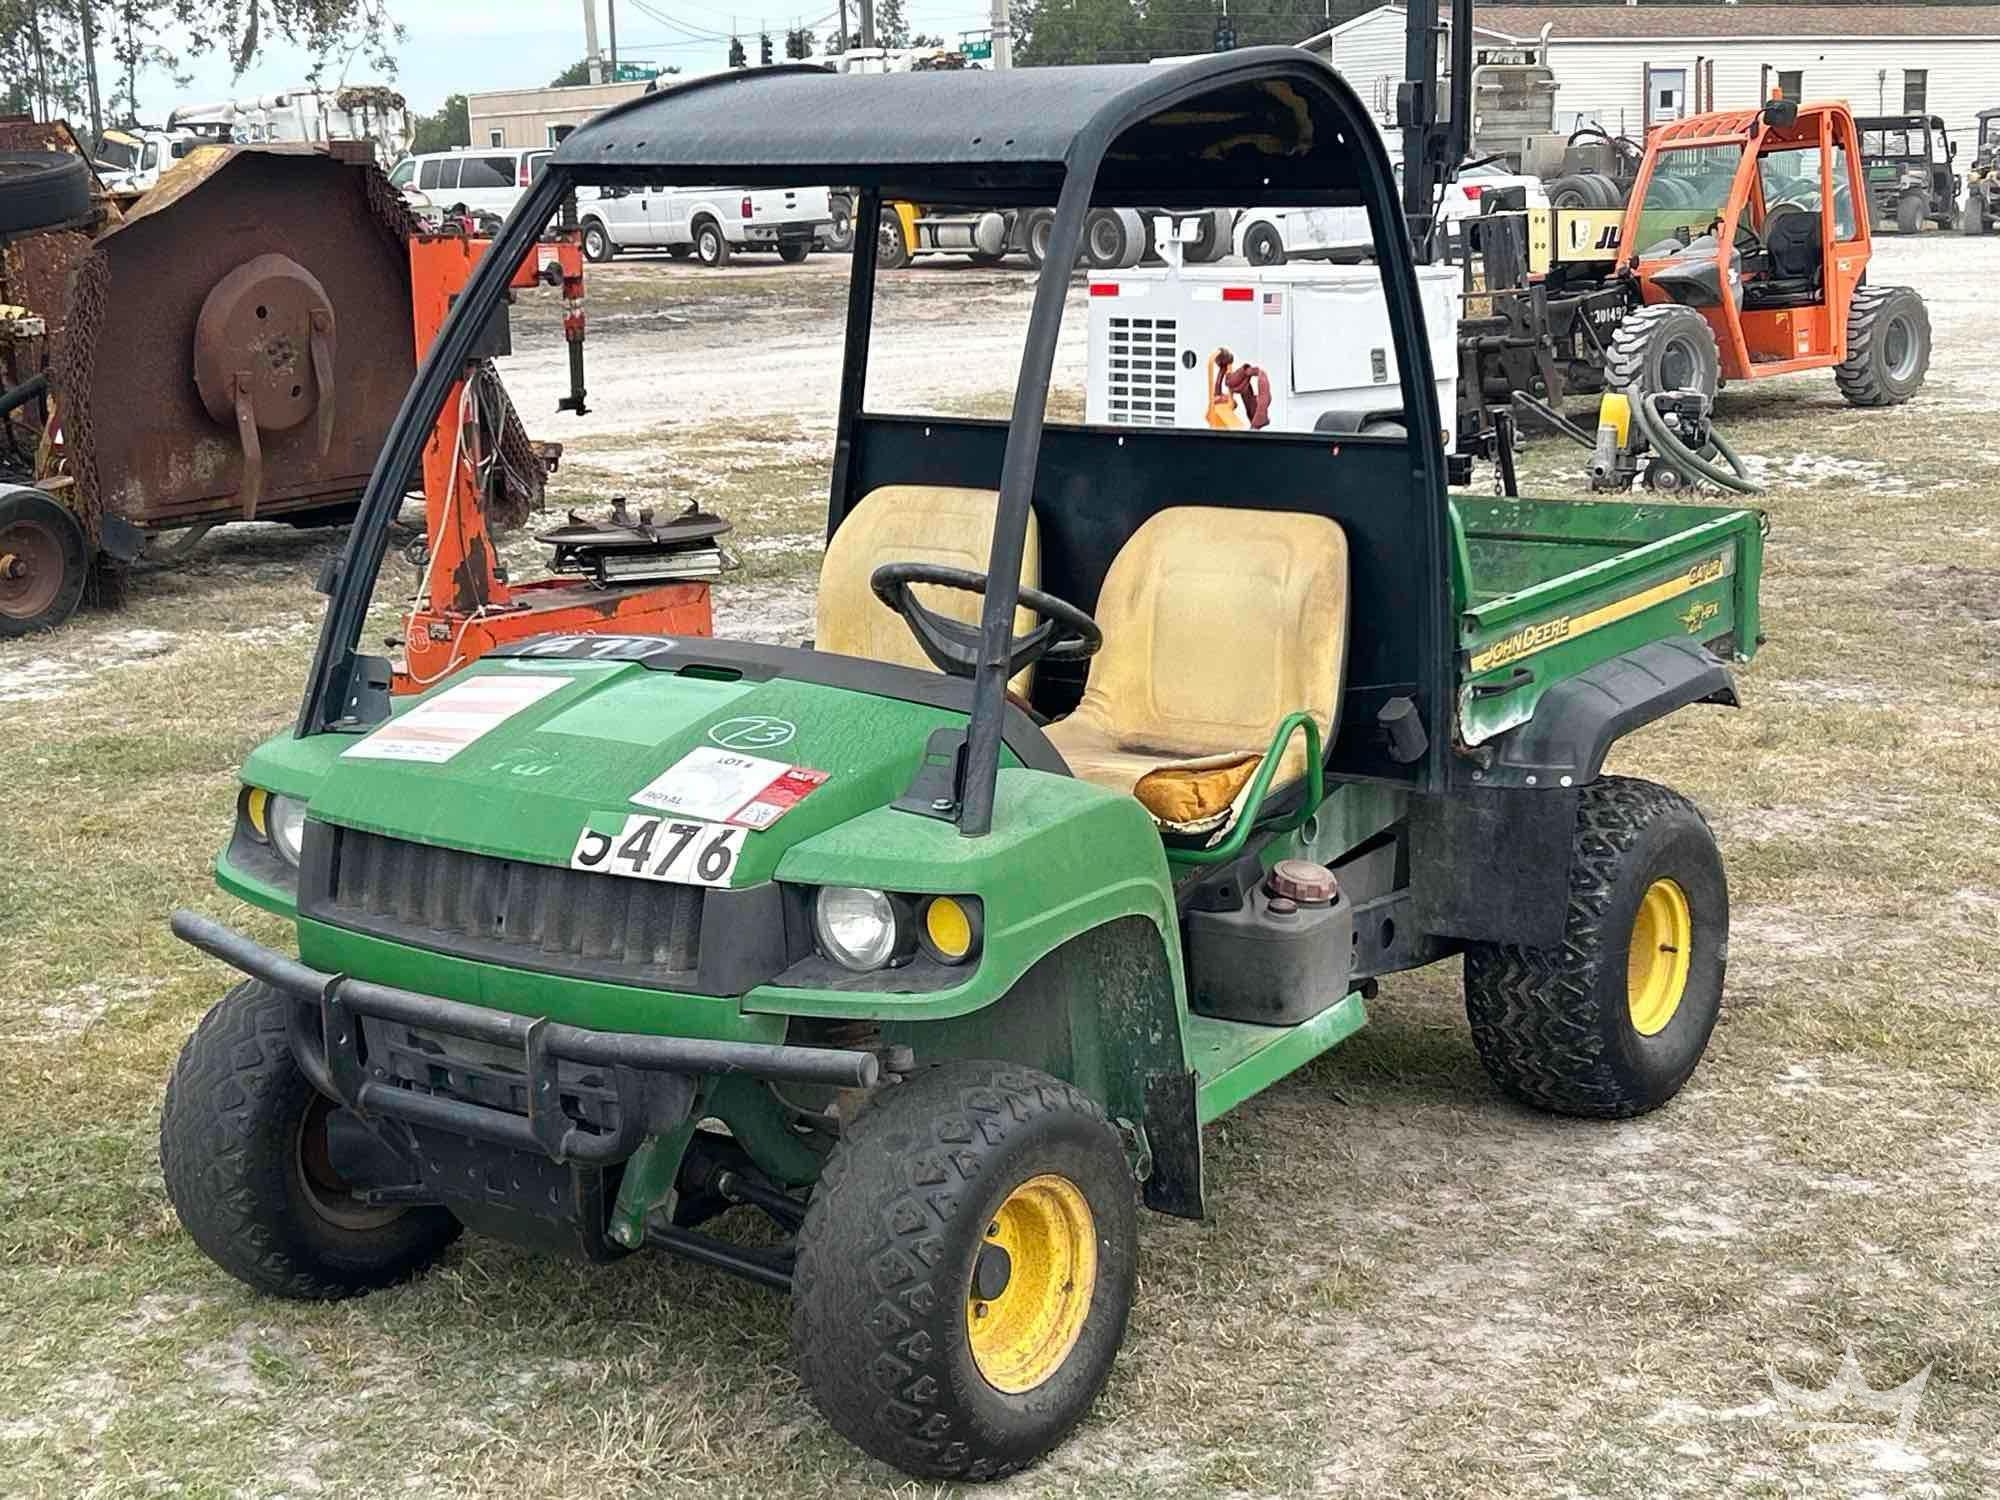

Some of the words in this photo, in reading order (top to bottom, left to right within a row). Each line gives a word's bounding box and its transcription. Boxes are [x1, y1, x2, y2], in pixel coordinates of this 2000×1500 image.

[1594, 225, 1624, 250] JL
[715, 756, 746, 768] LOT
[577, 819, 736, 882] 5476
